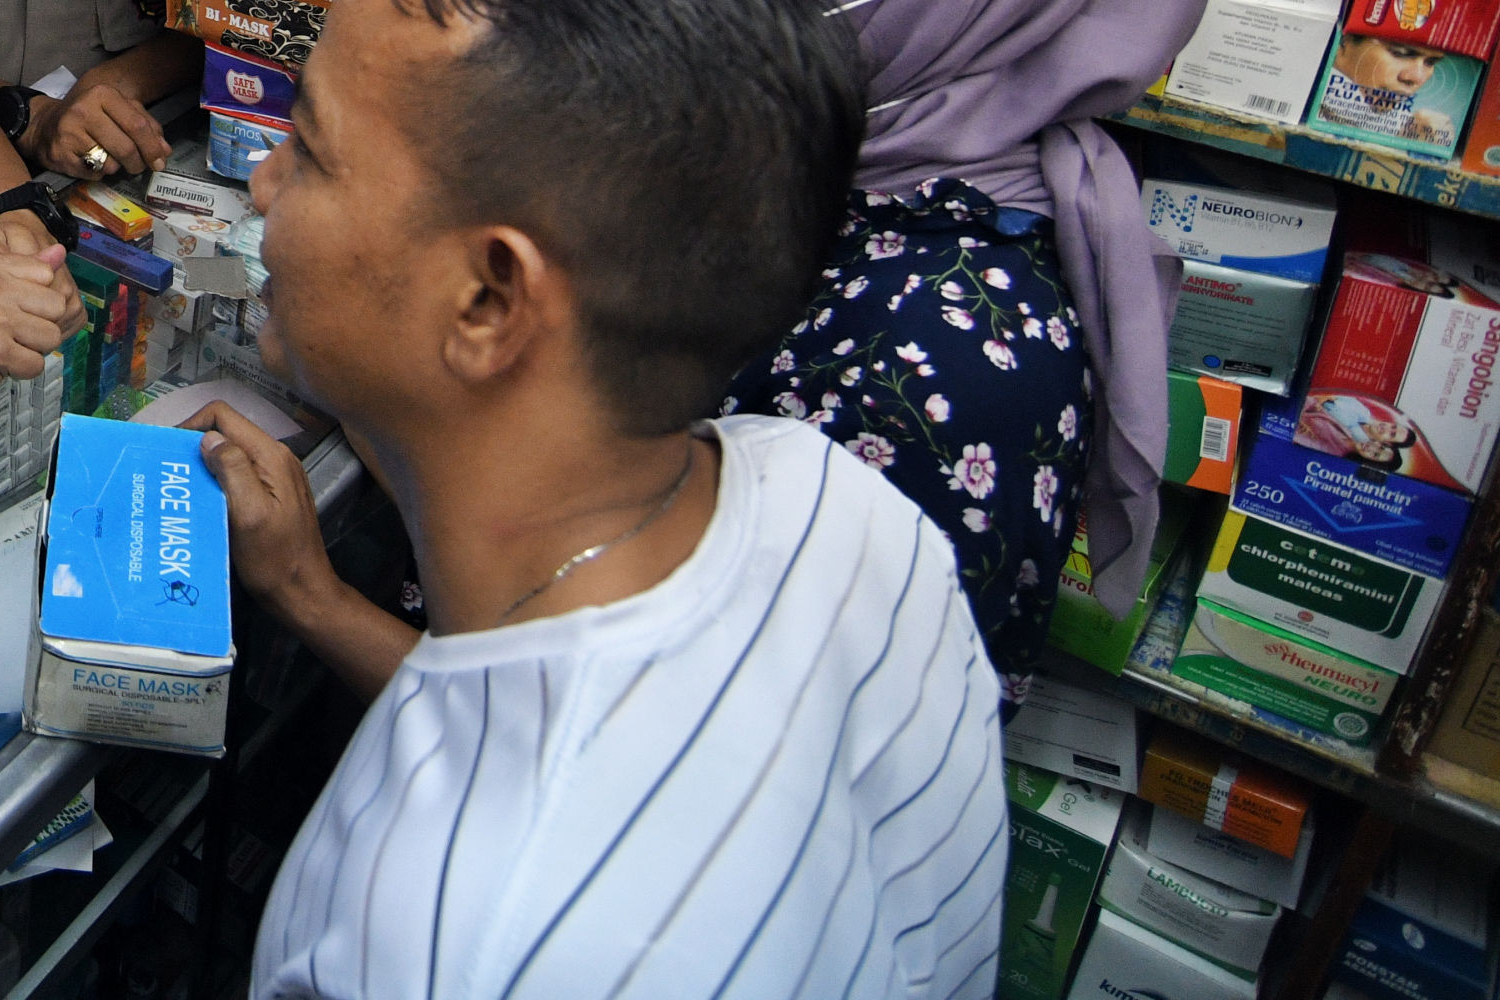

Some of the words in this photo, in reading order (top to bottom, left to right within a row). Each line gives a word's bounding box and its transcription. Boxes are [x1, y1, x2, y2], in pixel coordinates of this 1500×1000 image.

[205, 6, 221, 22] BI
[229, 13, 271, 37] MASK
[232, 85, 259, 100] MASK
[233, 76, 256, 90] SAFE
[1326, 87, 1352, 100] FLU
[1364, 96, 1413, 113] BATUK
[1400, 113, 1415, 124] mg
[154, 183, 216, 208] Counterpain
[1201, 200, 1293, 226] NEUROBION
[1186, 275, 1237, 293] ANTIMO
[131, 472, 145, 523] SURGICAL
[160, 461, 190, 510] FACE
[1244, 480, 1285, 504] 250
[1303, 474, 1352, 500] Pirantel
[1352, 491, 1404, 515] pamoat
[1305, 460, 1411, 506] Combantrin
[128, 523, 144, 583] DISPOSABLE
[159, 516, 190, 579] MASK
[1277, 570, 1345, 603] maleas
[73, 668, 131, 690] FACE
[138, 677, 201, 697] MASK
[1283, 650, 1380, 694] rheumacyl
[72, 684, 119, 698] SURGICAL
[1303, 675, 1377, 706] NEURO
